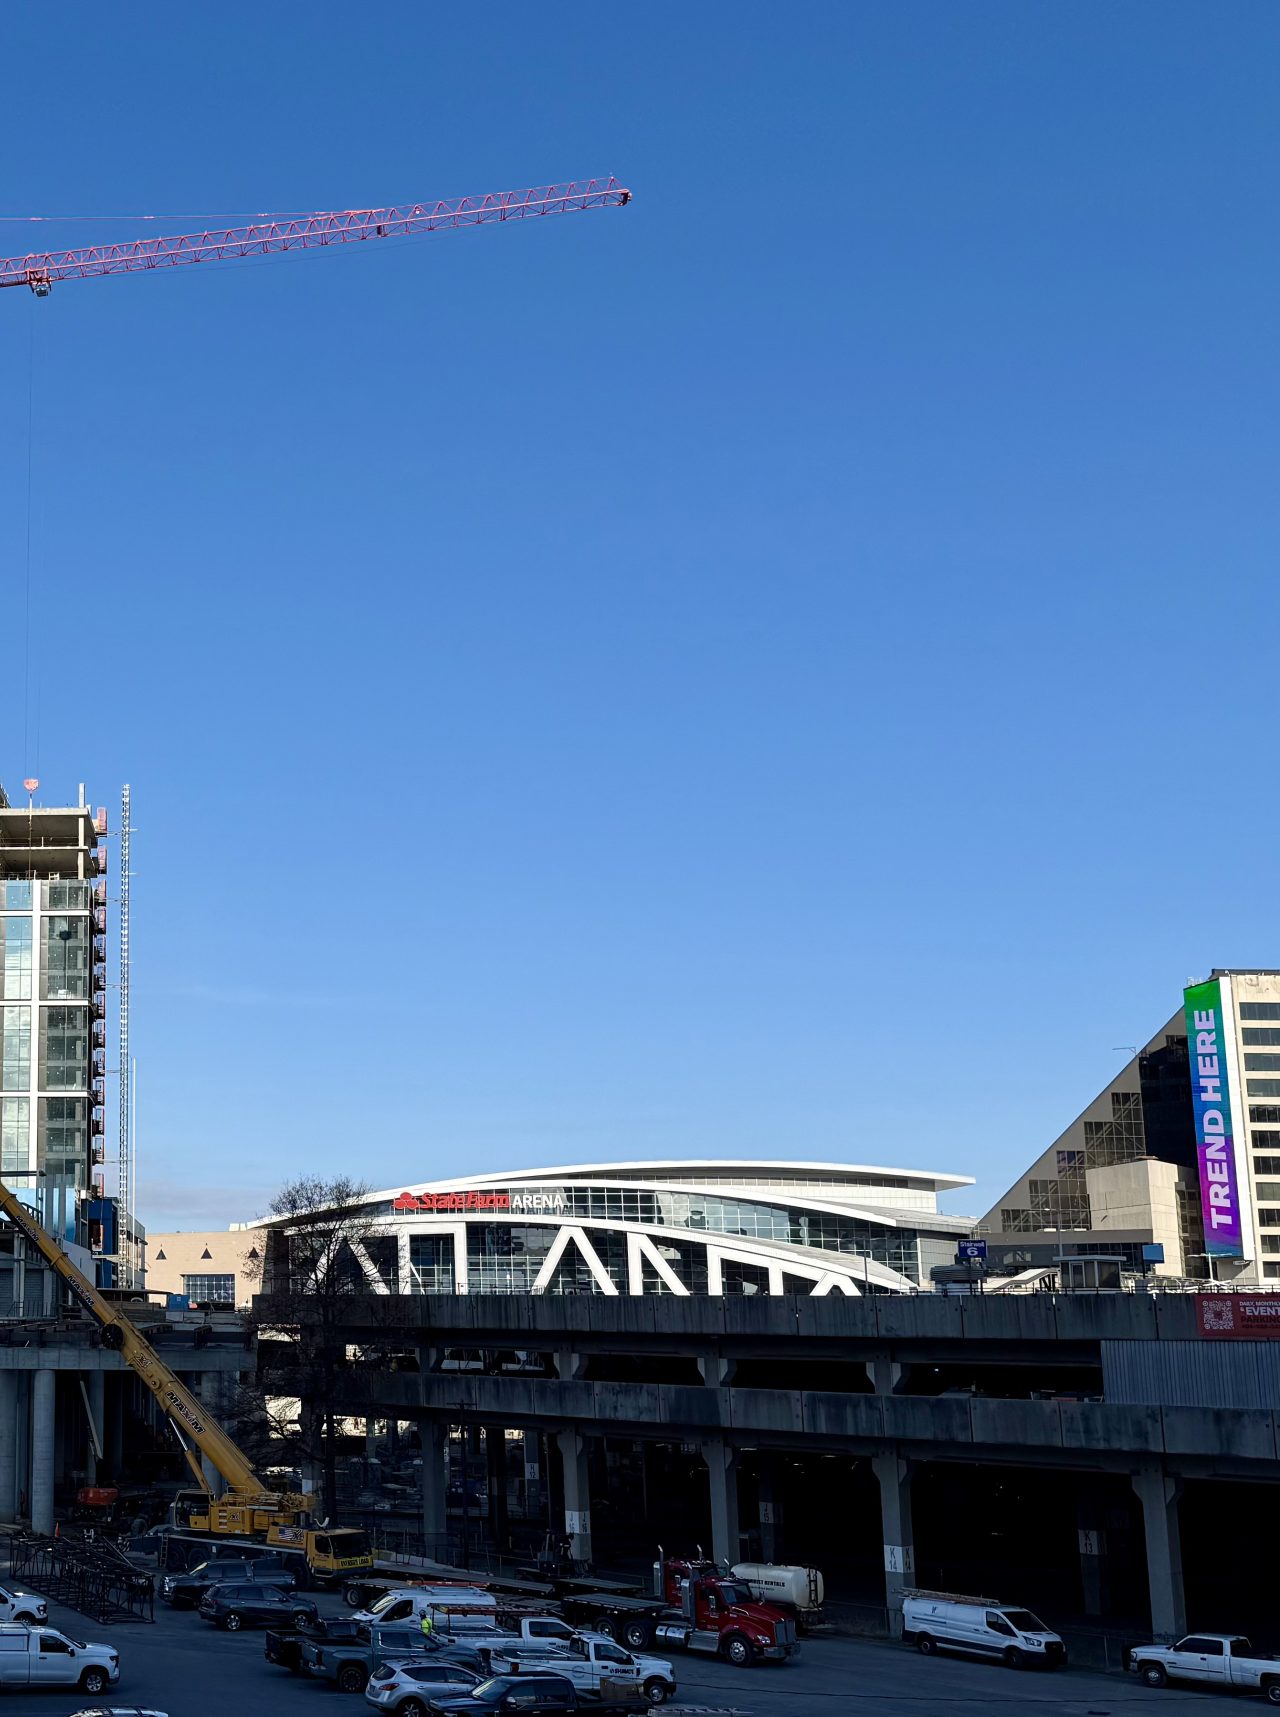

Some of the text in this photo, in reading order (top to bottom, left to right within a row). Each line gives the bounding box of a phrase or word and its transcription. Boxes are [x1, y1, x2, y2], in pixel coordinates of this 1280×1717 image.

[1193, 1008, 1233, 1230] TREND HERE
[421, 1191, 565, 1209] State Farm ARENA
[966, 1247, 978, 1256] 6
[67, 1274, 95, 1307] MAXIM
[166, 1390, 207, 1435] MAXIM
[889, 1547, 896, 1559] K
[888, 1560, 898, 1572] 14
